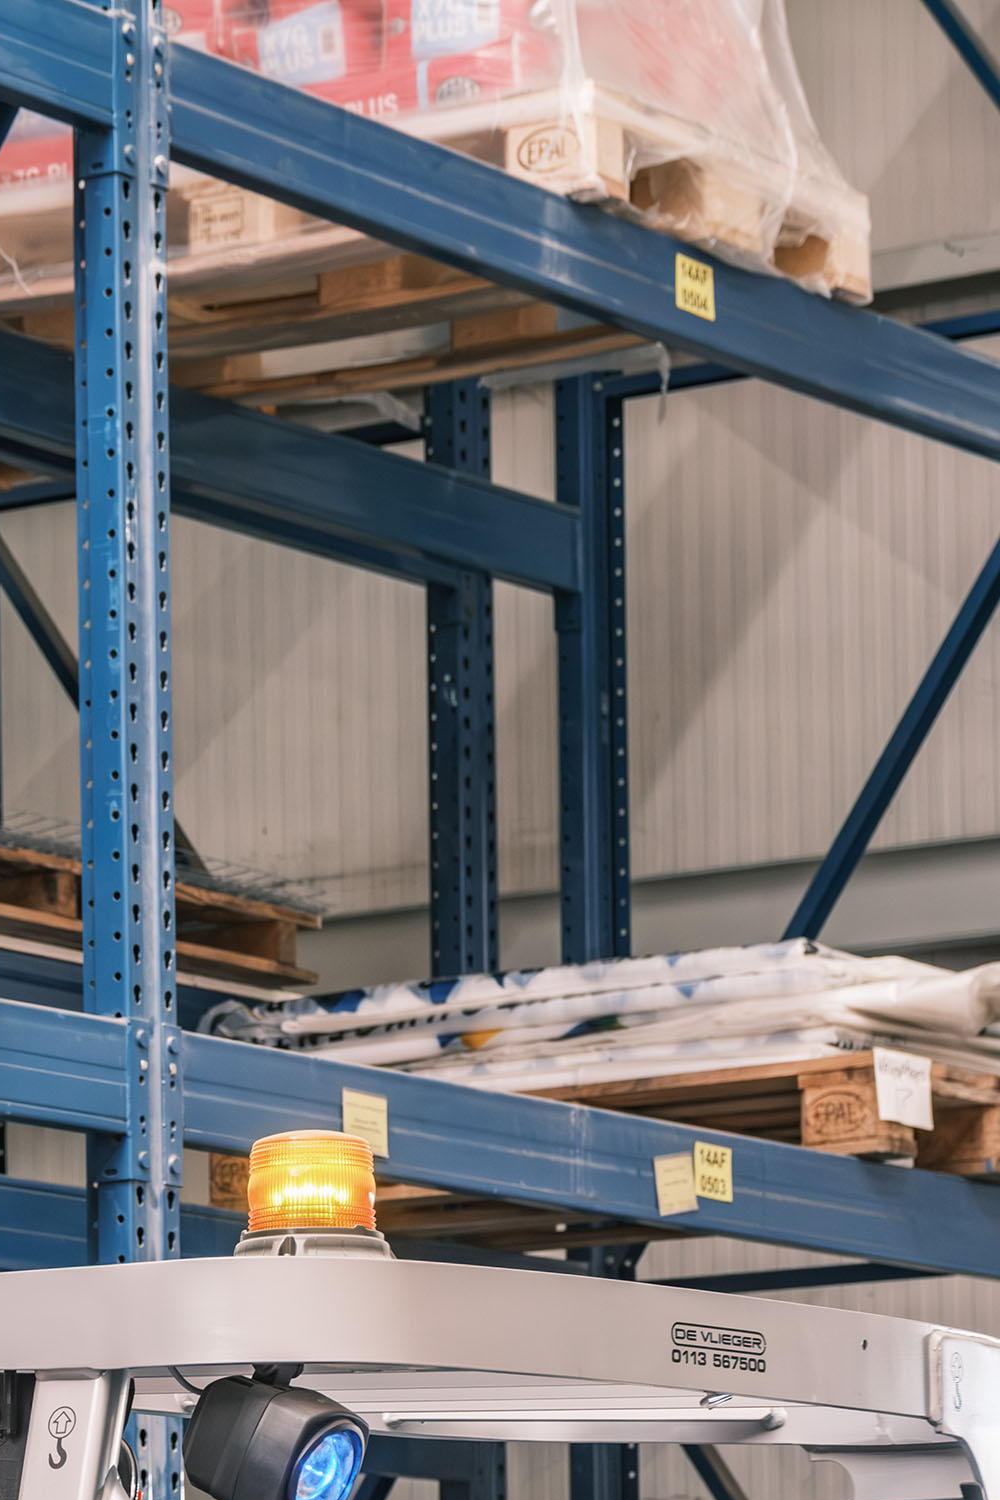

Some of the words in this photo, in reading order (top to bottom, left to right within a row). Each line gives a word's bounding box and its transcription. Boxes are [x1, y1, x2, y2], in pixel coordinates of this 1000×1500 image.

[700, 1148, 728, 1169] 14AF
[700, 1175, 728, 1196] 0503
[675, 1328, 697, 1342] DE
[700, 1330, 763, 1350] VLIEGER
[671, 1349, 707, 1366] 0113
[712, 1353, 766, 1373] 567500
